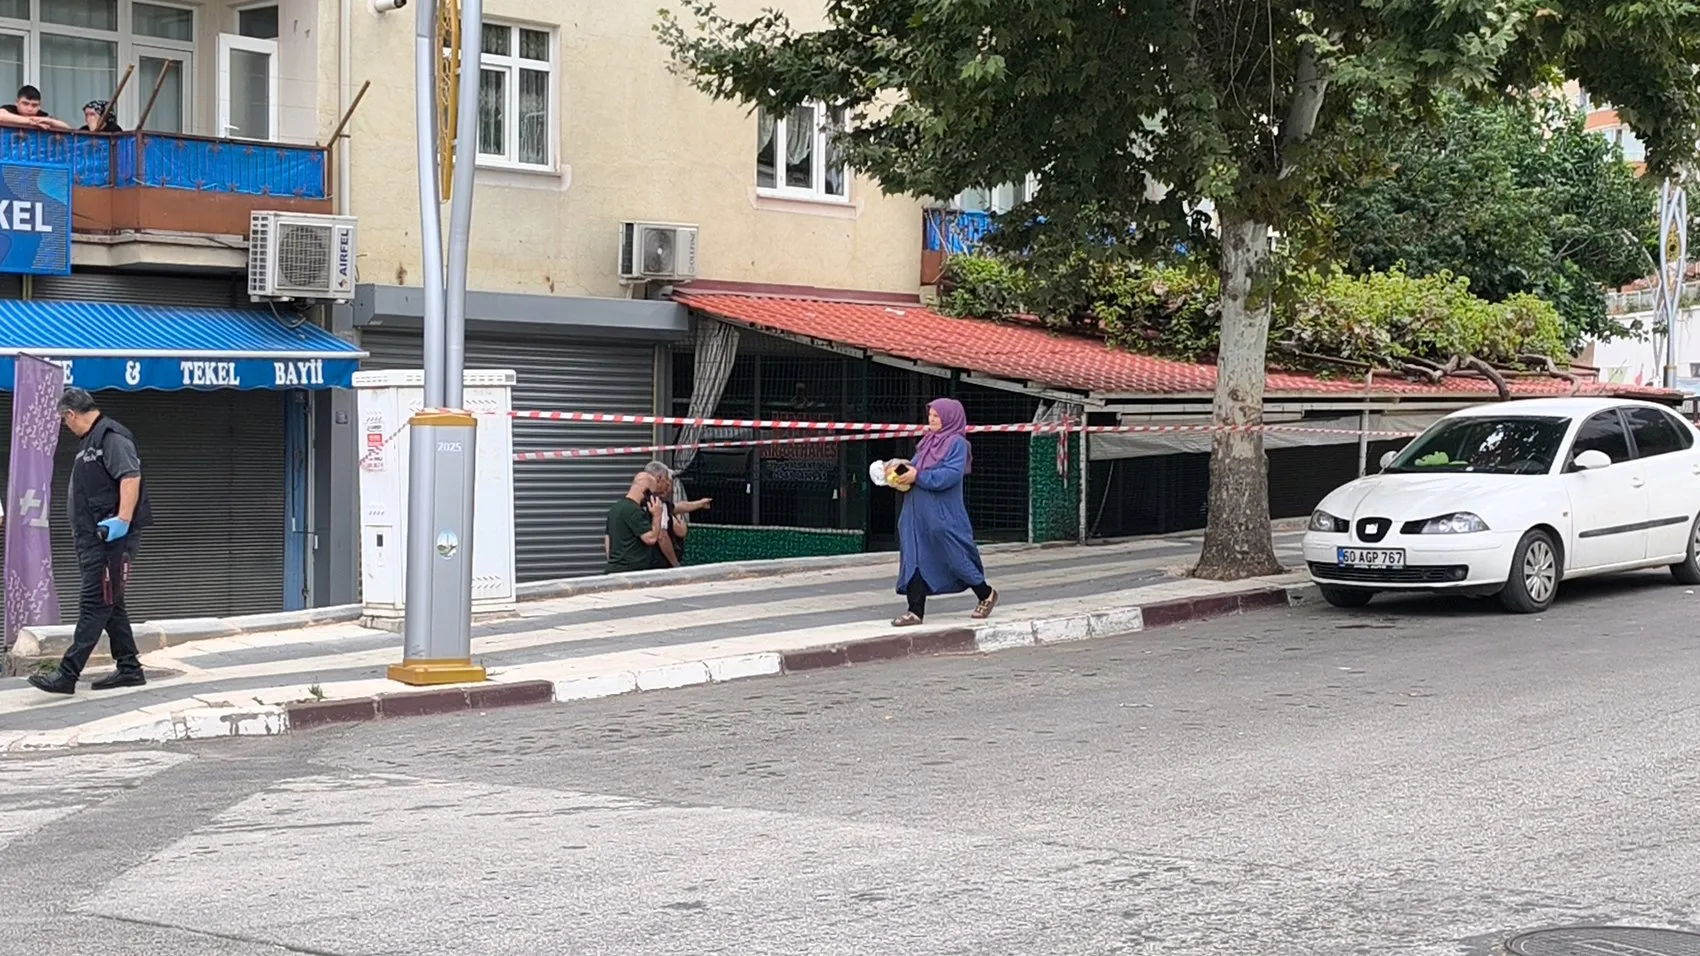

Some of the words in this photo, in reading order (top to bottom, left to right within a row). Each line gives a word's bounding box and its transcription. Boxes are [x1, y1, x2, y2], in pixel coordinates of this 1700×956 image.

[338, 229, 349, 276] AIRFEL
[125, 361, 141, 385] &
[181, 361, 240, 386] TEKEL
[436, 441, 462, 453] 2025
[1343, 550, 1356, 563] 60
[1358, 551, 1379, 564] AGP
[1381, 551, 1403, 565] 767
